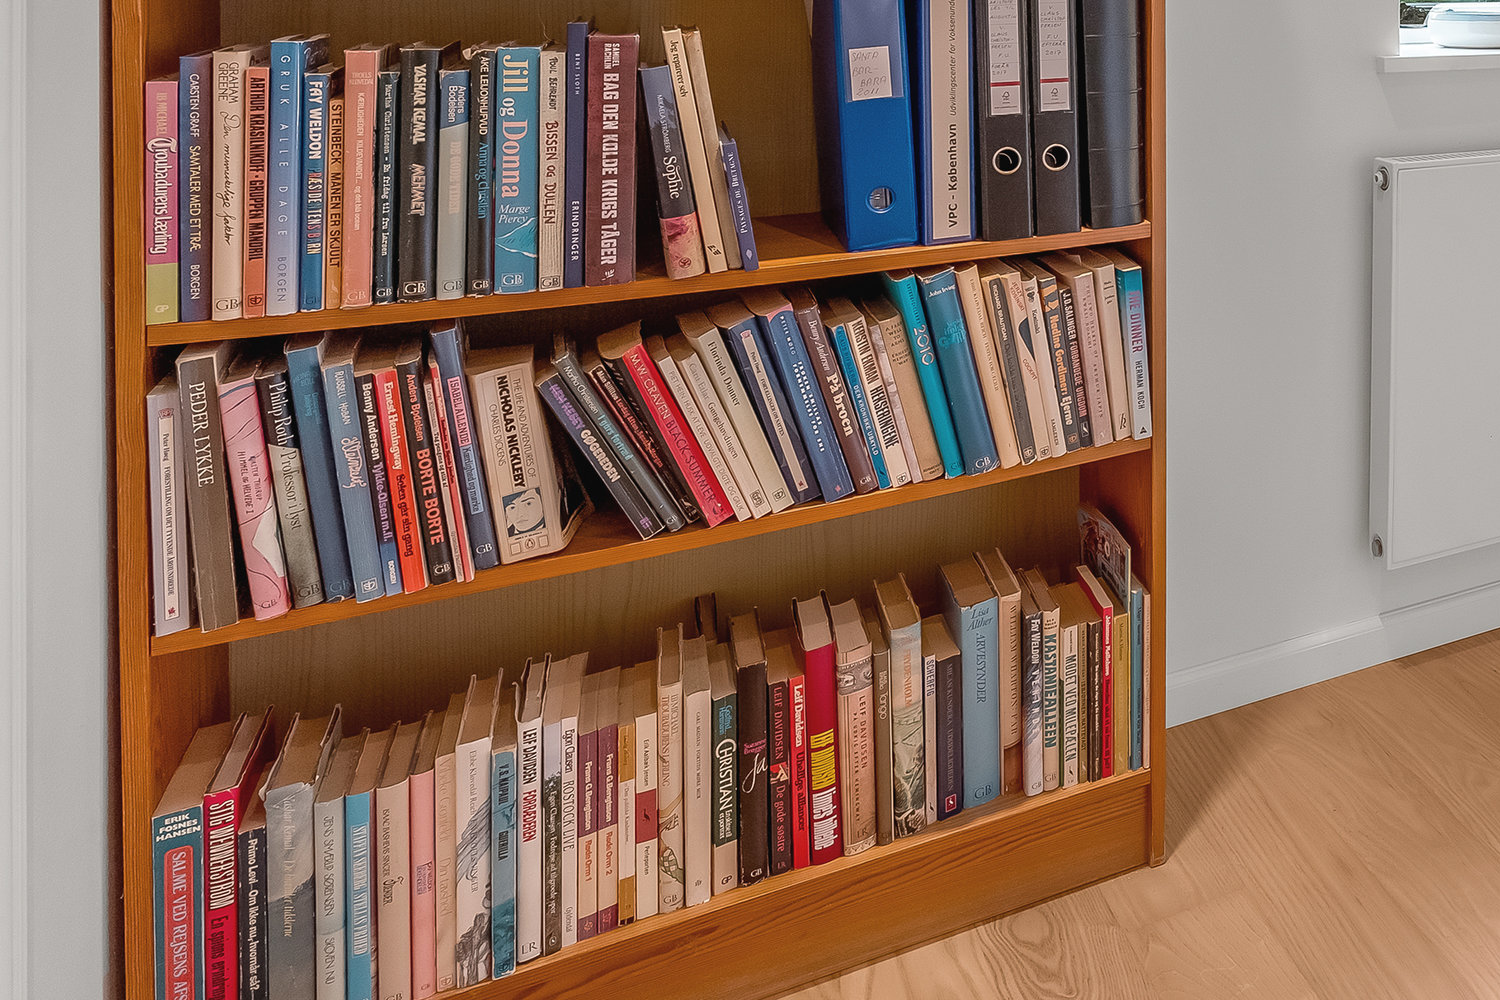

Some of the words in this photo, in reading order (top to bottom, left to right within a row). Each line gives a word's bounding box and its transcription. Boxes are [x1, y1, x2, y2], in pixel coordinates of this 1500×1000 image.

[190, 74, 199, 110] CARSTEN
[218, 63, 228, 101] GREENE
[229, 62, 239, 104] GRAHAM
[310, 81, 322, 103] FAY
[413, 64, 426, 105] YASHAR
[502, 55, 529, 93] Jill
[603, 74, 619, 99] BAG
[251, 77, 265, 111] ARTHUR
[499, 97, 515, 116] og
[190, 112, 199, 137] GRAFF
[309, 108, 321, 159] WELDON
[330, 105, 341, 164] STEINBECK
[412, 108, 426, 145] KEMAL
[603, 104, 618, 129] DEN
[250, 114, 265, 173] KRASILNIKOFF
[502, 120, 528, 198] Donna
[546, 121, 559, 160] BISSEN
[602, 135, 618, 175] KOLDE
[946, 124, 958, 191] København
[146, 137, 178, 214] Troubadurens
[189, 145, 200, 191] SAMTALER
[547, 165, 556, 177] OG
[662, 156, 683, 199] Sophie
[190, 194, 201, 215] MED
[249, 180, 264, 219] GRUPPEN
[411, 164, 425, 216] MEHMET
[544, 183, 557, 224] DULLEN
[601, 180, 617, 218] KRIGS
[190, 219, 200, 228] ET
[330, 213, 340, 226] ER
[571, 201, 579, 261] ERINDRINGER
[947, 203, 958, 228] VPC
[150, 216, 173, 254] lærling
[190, 230, 201, 252] TRÆ
[248, 223, 264, 262] MANDRIL
[329, 230, 340, 268] SKJULT
[600, 222, 620, 264] TÅGER
[1129, 290, 1141, 311] THE
[852, 320, 873, 356] KERSTIN
[913, 324, 934, 366] 2010
[1049, 315, 1061, 348] Nadine
[1130, 314, 1143, 353] DINNER
[630, 353, 648, 379] M.W.
[643, 380, 671, 420] CRAVEN
[861, 358, 879, 384] EKMAN
[1055, 349, 1069, 396] Gordimer:
[188, 382, 210, 431] PEDER
[267, 381, 287, 416] Philip
[362, 382, 375, 413] Benny
[384, 382, 398, 414] Ernest
[448, 378, 465, 405] ISABEL
[826, 372, 840, 394] På
[833, 395, 854, 437] broen
[1061, 396, 1073, 425] Ejerne
[273, 416, 291, 447] Roth
[453, 405, 470, 444] ALLENDE
[497, 375, 515, 433] NICHOLAS
[507, 436, 525, 488] NICKLEBY
[870, 384, 899, 449] HEKSERINGENE
[366, 415, 380, 460] Andersen
[386, 414, 403, 470] Hemingway
[580, 429, 620, 482] GØGEREDEN
[195, 437, 214, 487] LYKKE
[280, 451, 302, 501] Professor
[417, 448, 436, 495] BORTE
[373, 462, 389, 520] Tykke-Olsen
[286, 510, 303, 530] lyst
[381, 521, 393, 542] m.fl.
[426, 497, 444, 545] BORTE
[926, 660, 935, 696] SCHERFIG
[976, 633, 986, 703] ARVESYNDER
[1065, 654, 1076, 686] MODET
[879, 691, 888, 719] Tango
[1045, 634, 1057, 748] KASTANIEALLEEN
[1065, 690, 1076, 706] VED
[523, 728, 537, 745] LEIF
[1065, 709, 1076, 762] MILEPÆLEN
[522, 746, 537, 784] DAVIDSEN
[716, 739, 736, 810] CHRISTIAN
[563, 780, 575, 828] ROSTOCK
[776, 786, 786, 799] De
[209, 800, 234, 824] STIG
[523, 790, 536, 843] FORRÆDEREN
[774, 802, 786, 823] gode
[248, 839, 258, 865] Primo
[563, 828, 575, 851] LIVE
[777, 826, 786, 852] søstre
[172, 851, 187, 894] SALME
[209, 824, 235, 910] WENNERSTRÖM
[249, 865, 258, 883] Levi
[173, 895, 186, 921] VED
[248, 890, 258, 905] Om
[249, 907, 259, 924] ikke
[171, 924, 187, 976] REJSENS
[248, 926, 258, 941] nu,
[249, 941, 259, 974] hvornår
[249, 976, 259, 991] så?
